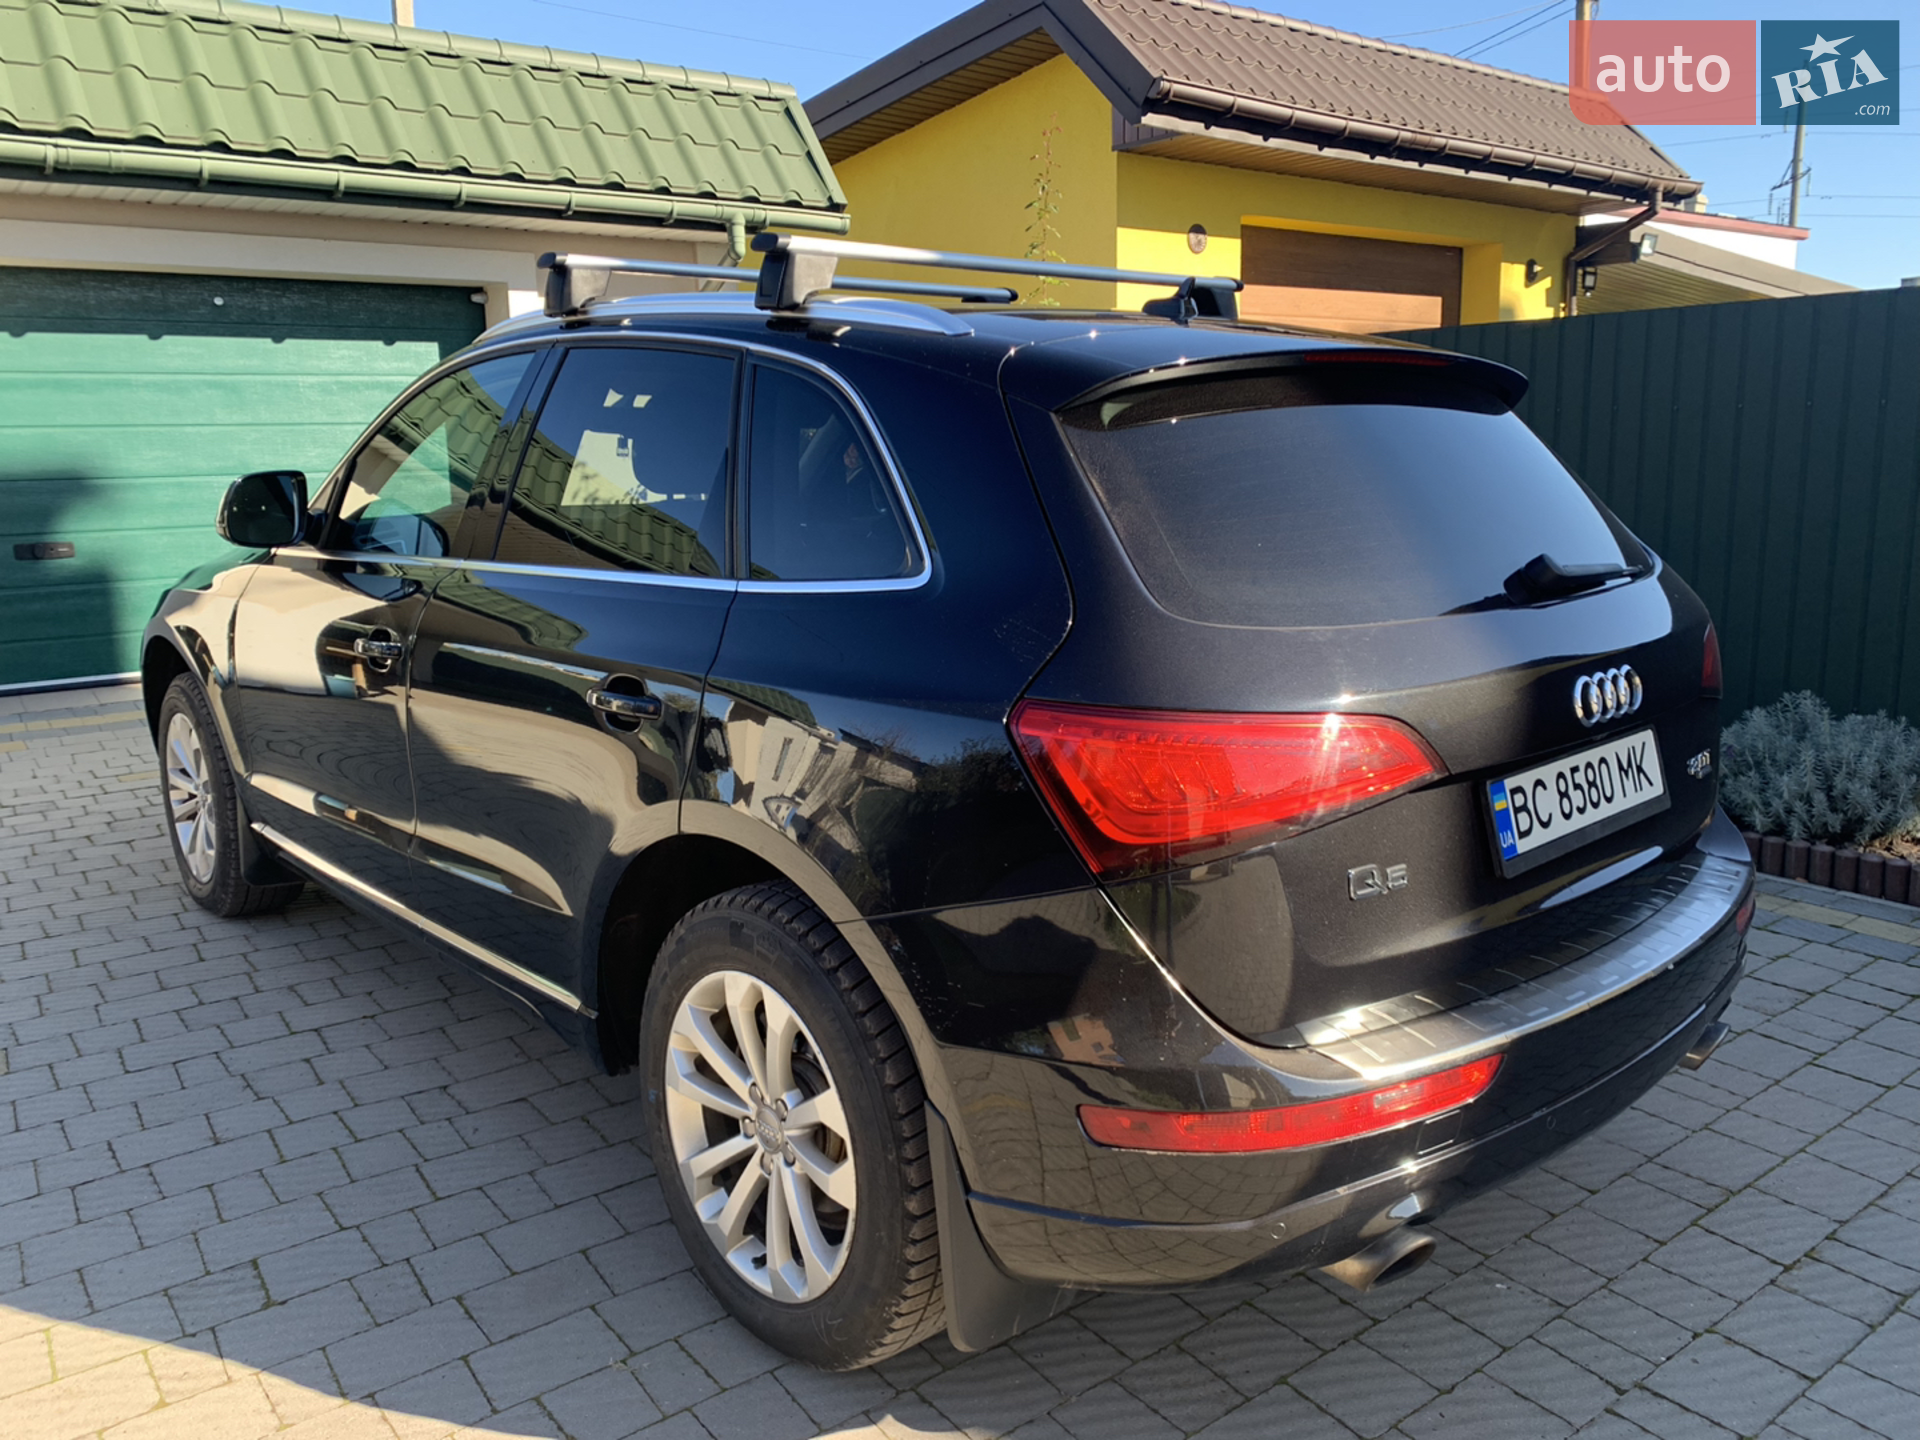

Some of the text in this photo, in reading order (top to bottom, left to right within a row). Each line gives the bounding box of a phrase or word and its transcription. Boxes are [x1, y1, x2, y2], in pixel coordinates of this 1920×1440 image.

[1509, 778, 1552, 840] BC
[1555, 755, 1614, 821] 8580
[1615, 741, 1654, 798] MK
[1499, 829, 1514, 848] UA
